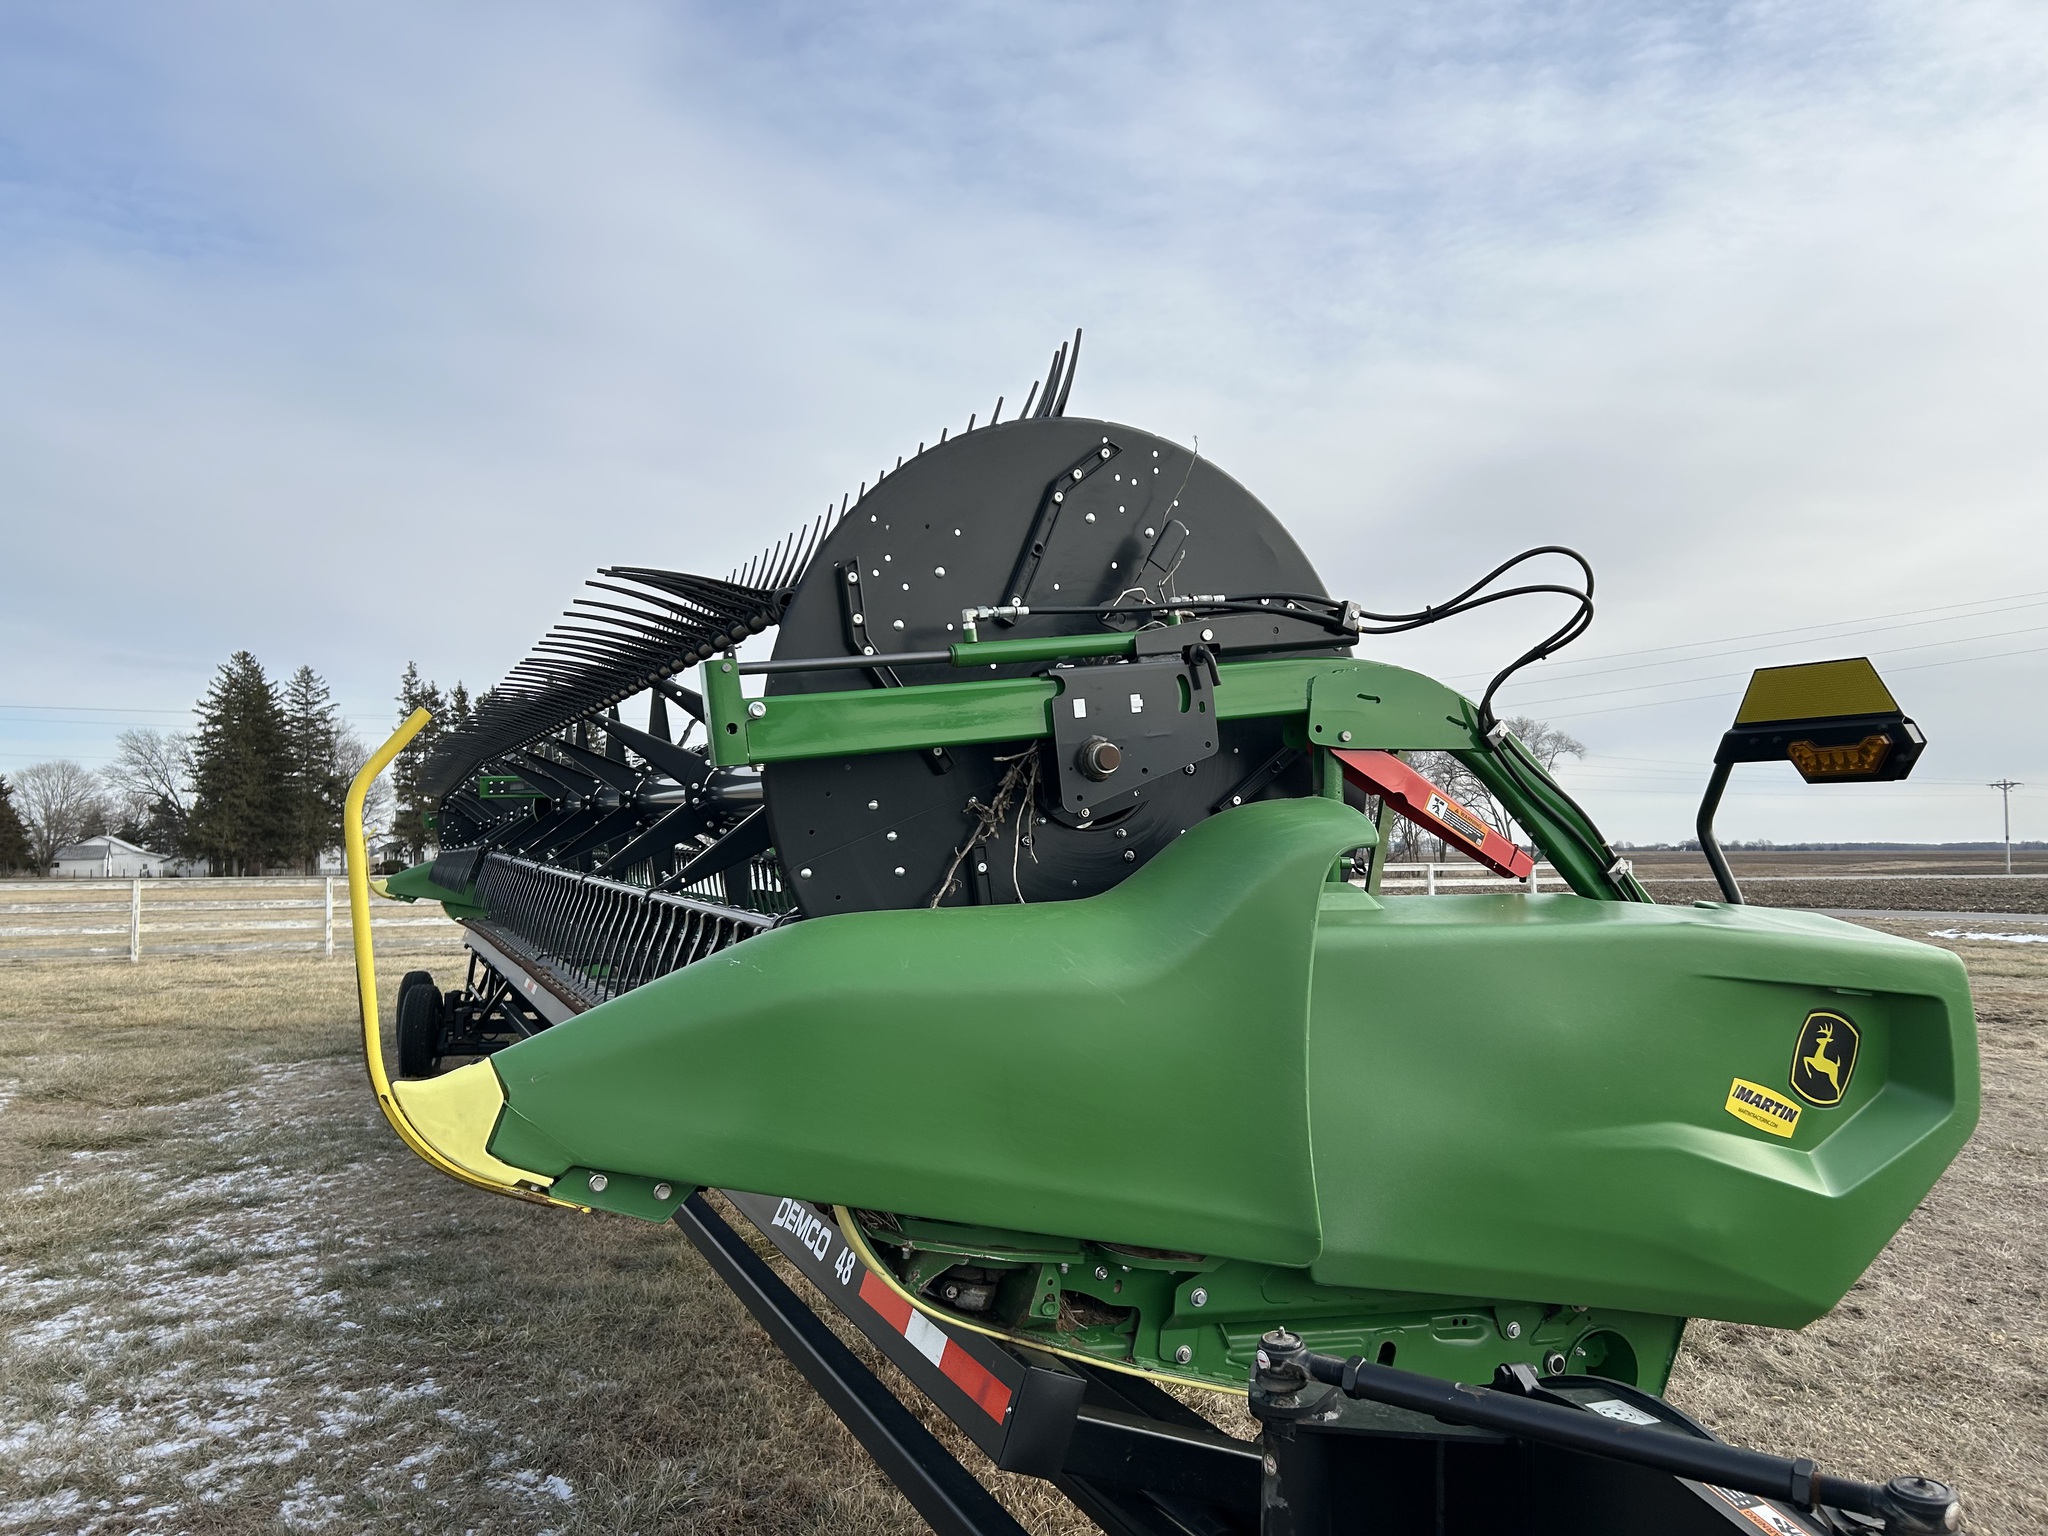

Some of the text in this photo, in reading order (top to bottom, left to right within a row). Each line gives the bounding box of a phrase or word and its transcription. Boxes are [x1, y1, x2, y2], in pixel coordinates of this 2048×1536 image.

[1460, 809, 1482, 829] WARNING
[1733, 1084, 1798, 1123] MARTIN
[771, 1197, 856, 1285] DEMCO 48
[1744, 1510, 1782, 1536] ARNING
